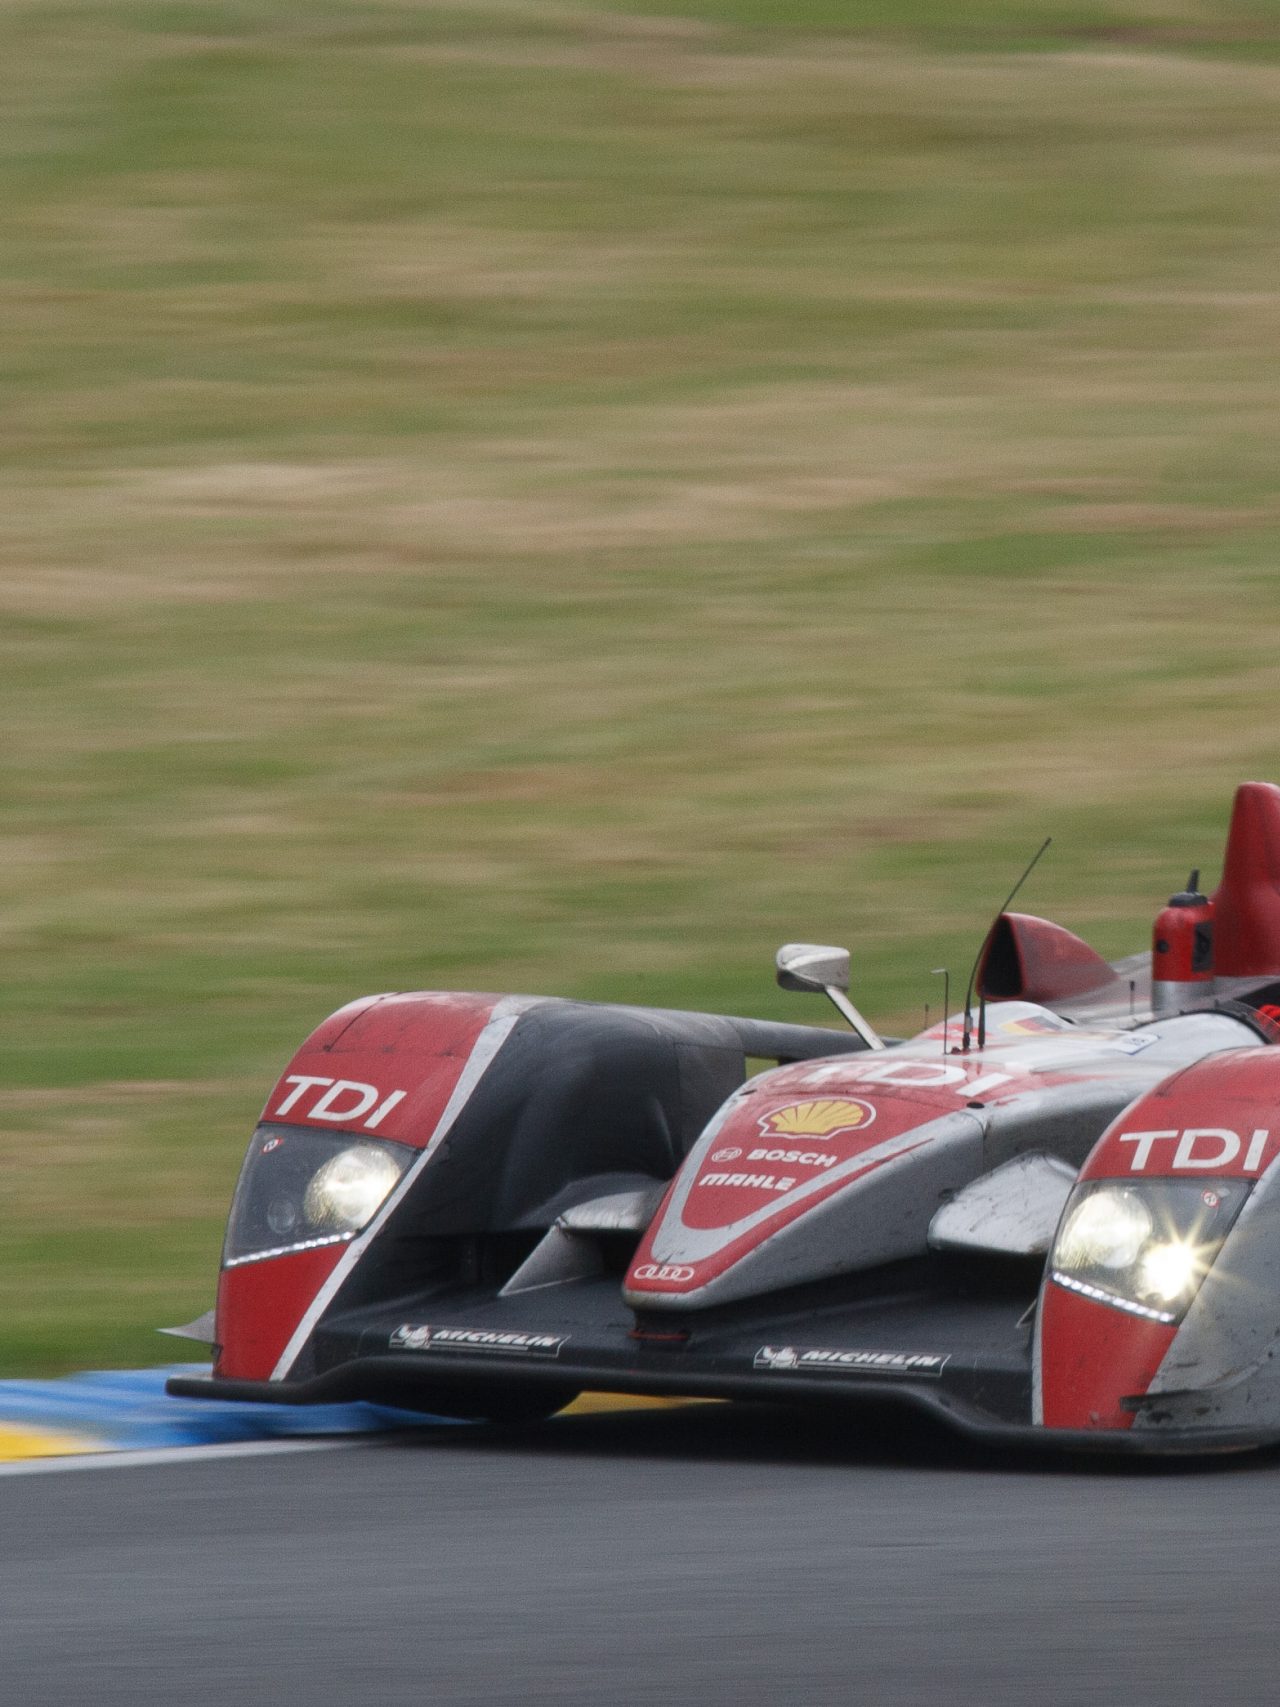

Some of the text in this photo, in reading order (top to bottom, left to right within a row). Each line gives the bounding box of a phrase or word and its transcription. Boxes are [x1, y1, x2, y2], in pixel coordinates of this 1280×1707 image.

[799, 1061, 1014, 1098] TDI
[275, 1074, 407, 1129] TDI
[746, 1148, 838, 1168] BOSCH
[1120, 1128, 1269, 1172] TDI
[698, 1173, 797, 1191] MAHLE
[432, 1328, 562, 1347] MICHELIN
[801, 1350, 942, 1367] MICHELIN
